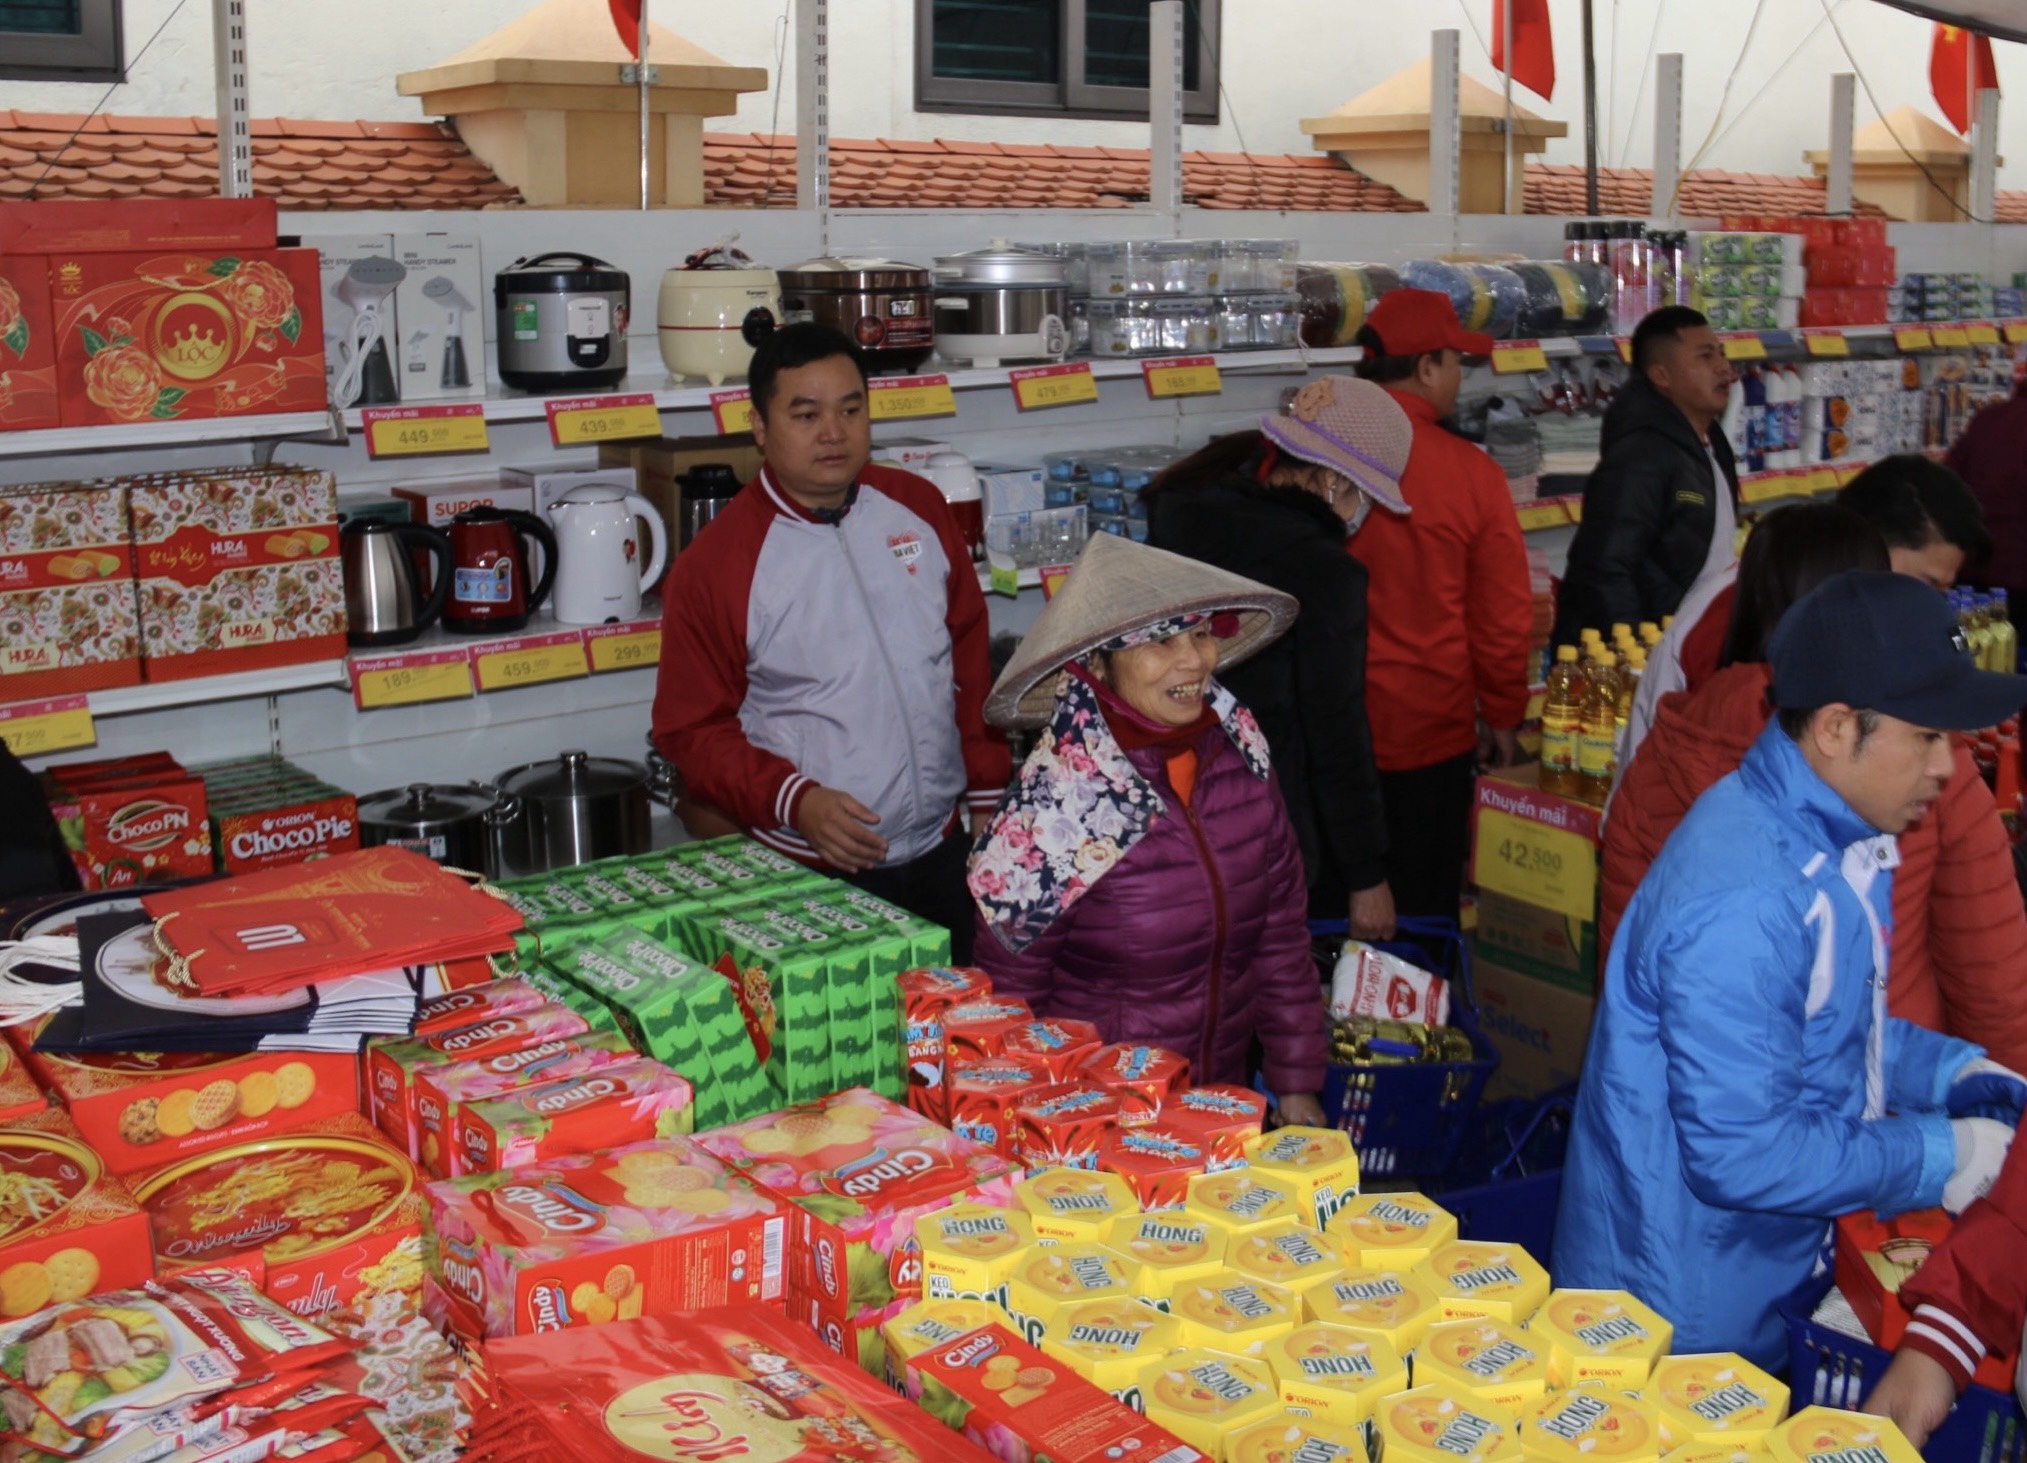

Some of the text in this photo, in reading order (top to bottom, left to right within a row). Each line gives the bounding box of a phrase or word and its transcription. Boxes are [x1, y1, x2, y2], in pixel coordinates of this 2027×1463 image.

[275, 812, 315, 828] ORION
[420, 992, 476, 1021] Cind
[444, 1019, 517, 1050] Cindy
[491, 1040, 568, 1073] Cindy
[377, 1070, 398, 1090] Cindy
[538, 1079, 616, 1112] Cindy
[419, 1097, 441, 1120] Cindy
[465, 1128, 488, 1151] Cindy
[844, 1150, 934, 1197] Cindy
[503, 1185, 596, 1231] Cindy
[444, 1258, 483, 1304] Cindy
[818, 1238, 837, 1296] Cindy
[944, 1333, 994, 1367] Cindy
